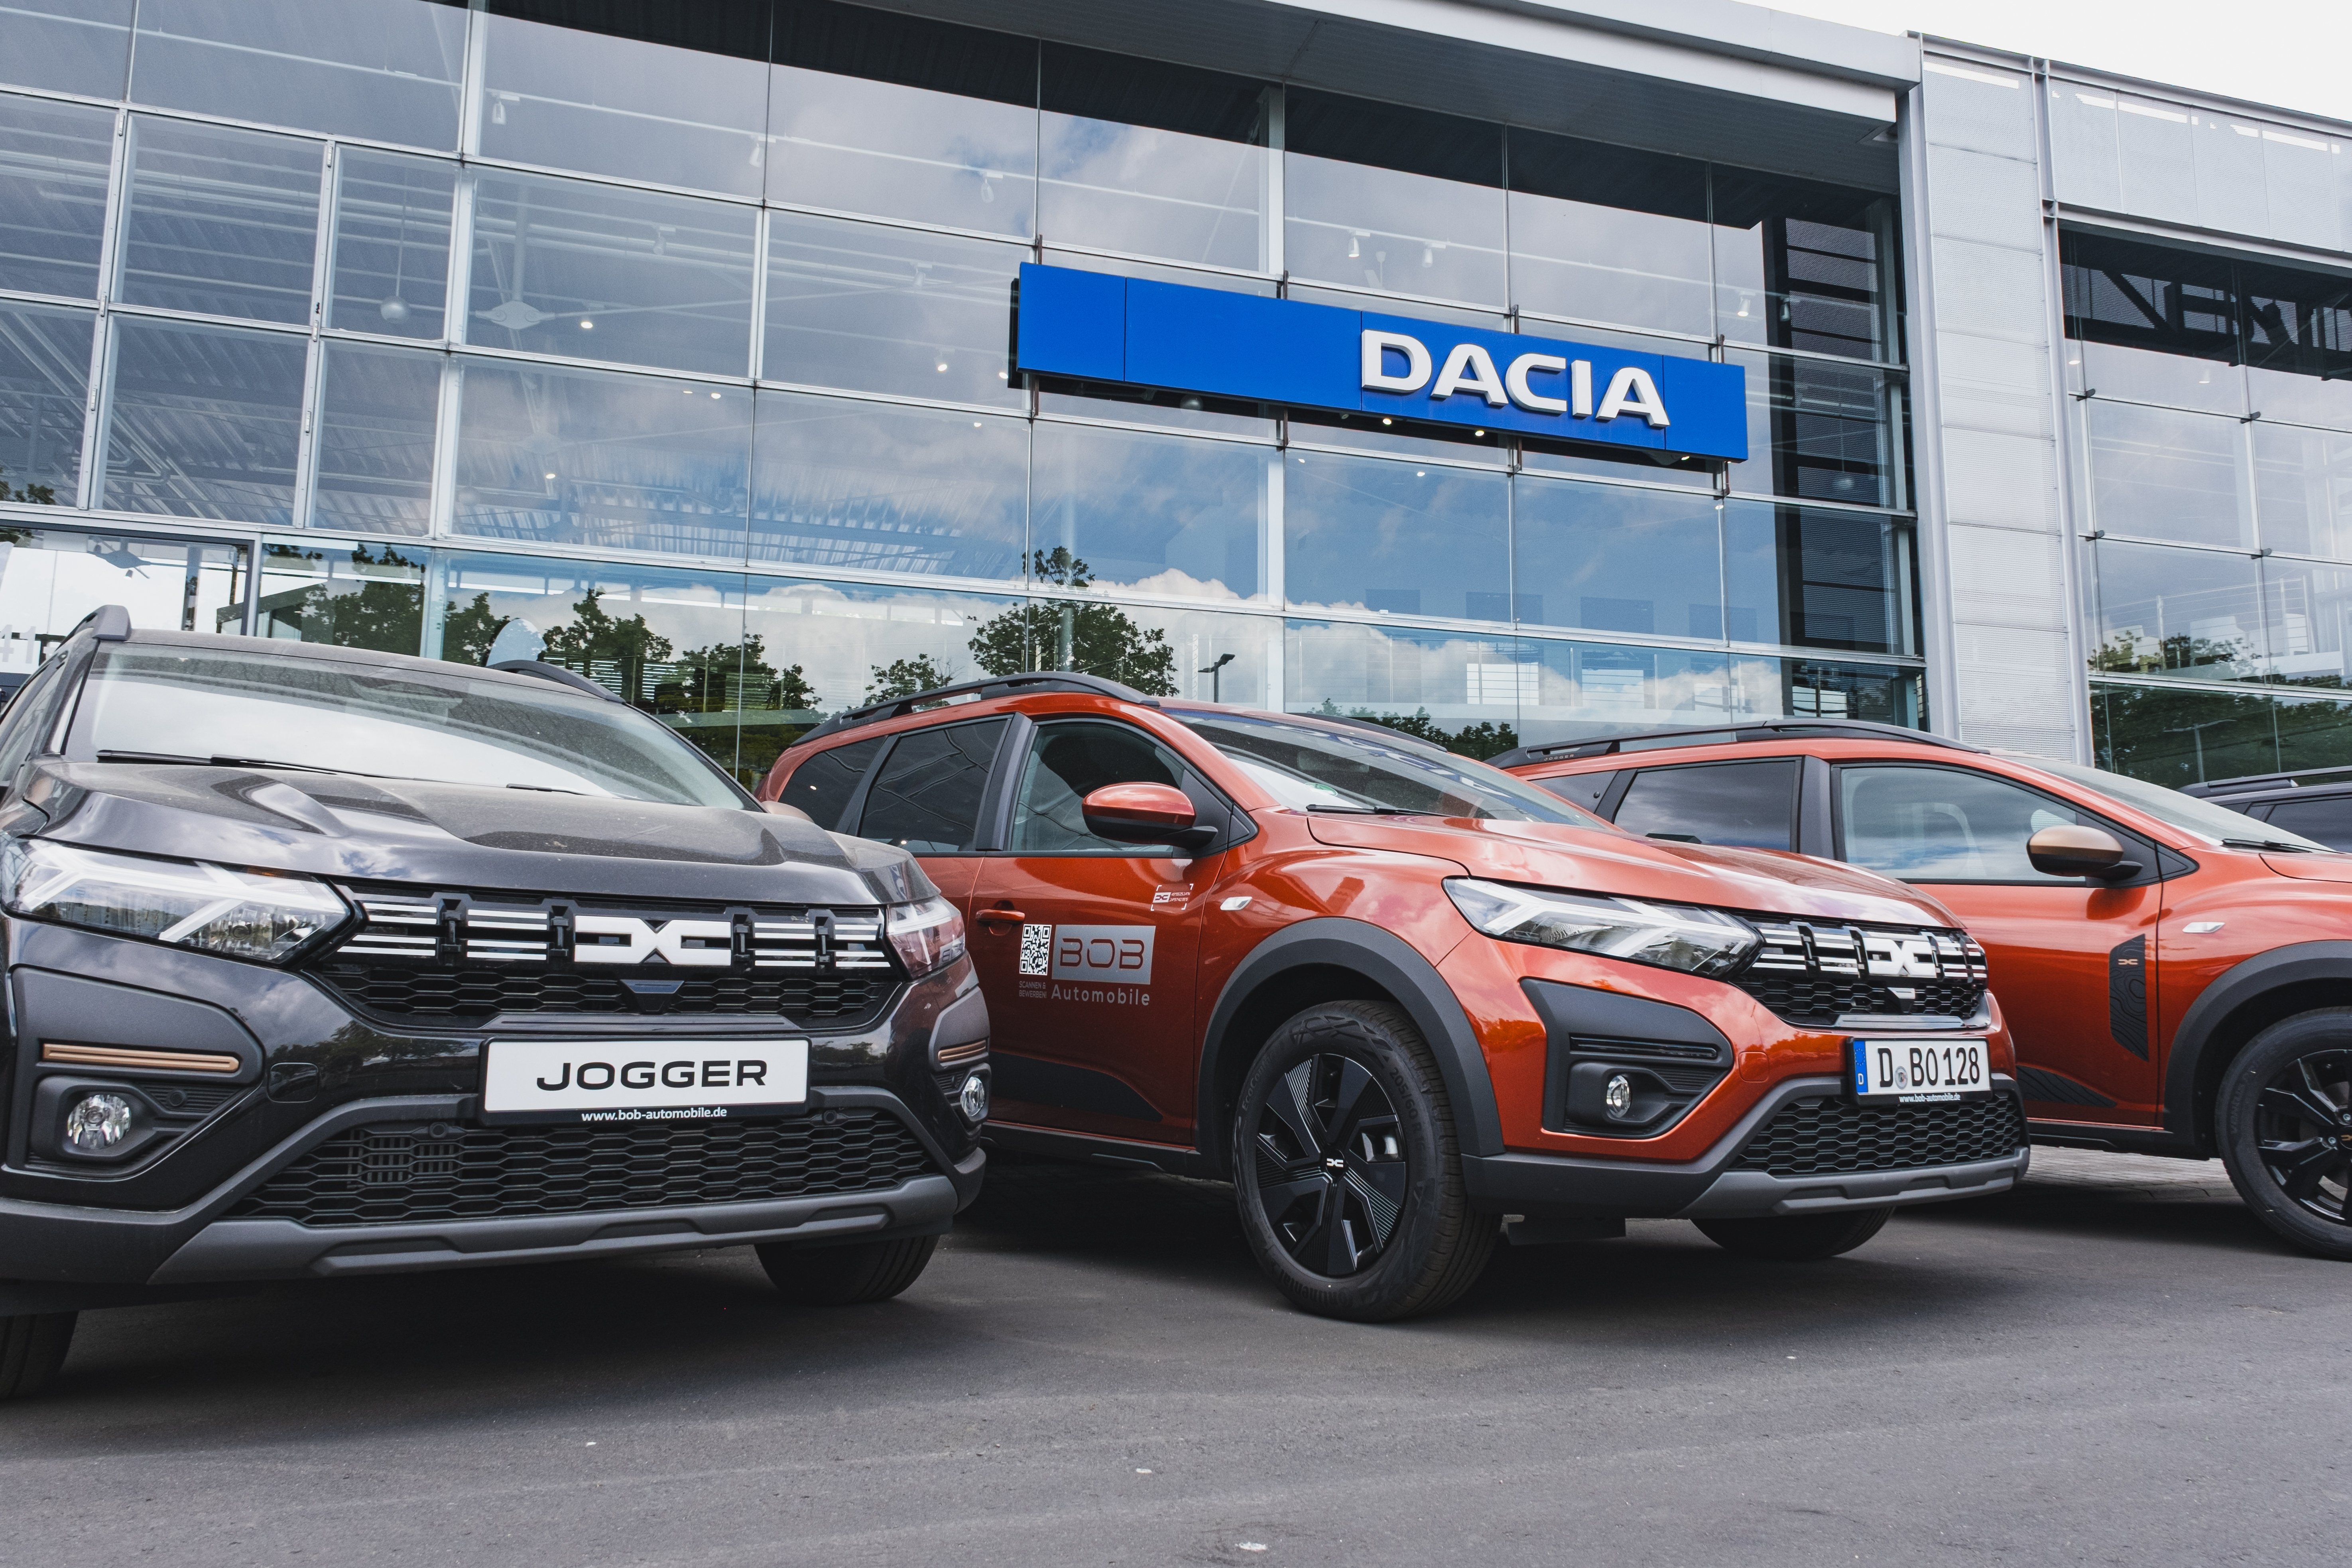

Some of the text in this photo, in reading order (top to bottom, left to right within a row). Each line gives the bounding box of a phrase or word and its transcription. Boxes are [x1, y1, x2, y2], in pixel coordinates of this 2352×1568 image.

[1362, 329, 1670, 428] DACIA
[1060, 938, 1145, 970] BOB
[1019, 990, 1047, 998] BEWERBEN!
[1051, 984, 1150, 1006] Automobile
[537, 1060, 767, 1091] JOGGER
[1858, 1073, 1864, 1085] D
[1878, 1048, 1893, 1088] D
[1899, 1093, 1960, 1103] www.bob-automobile.de
[582, 1107, 727, 1122] www.bob-automobile.de
